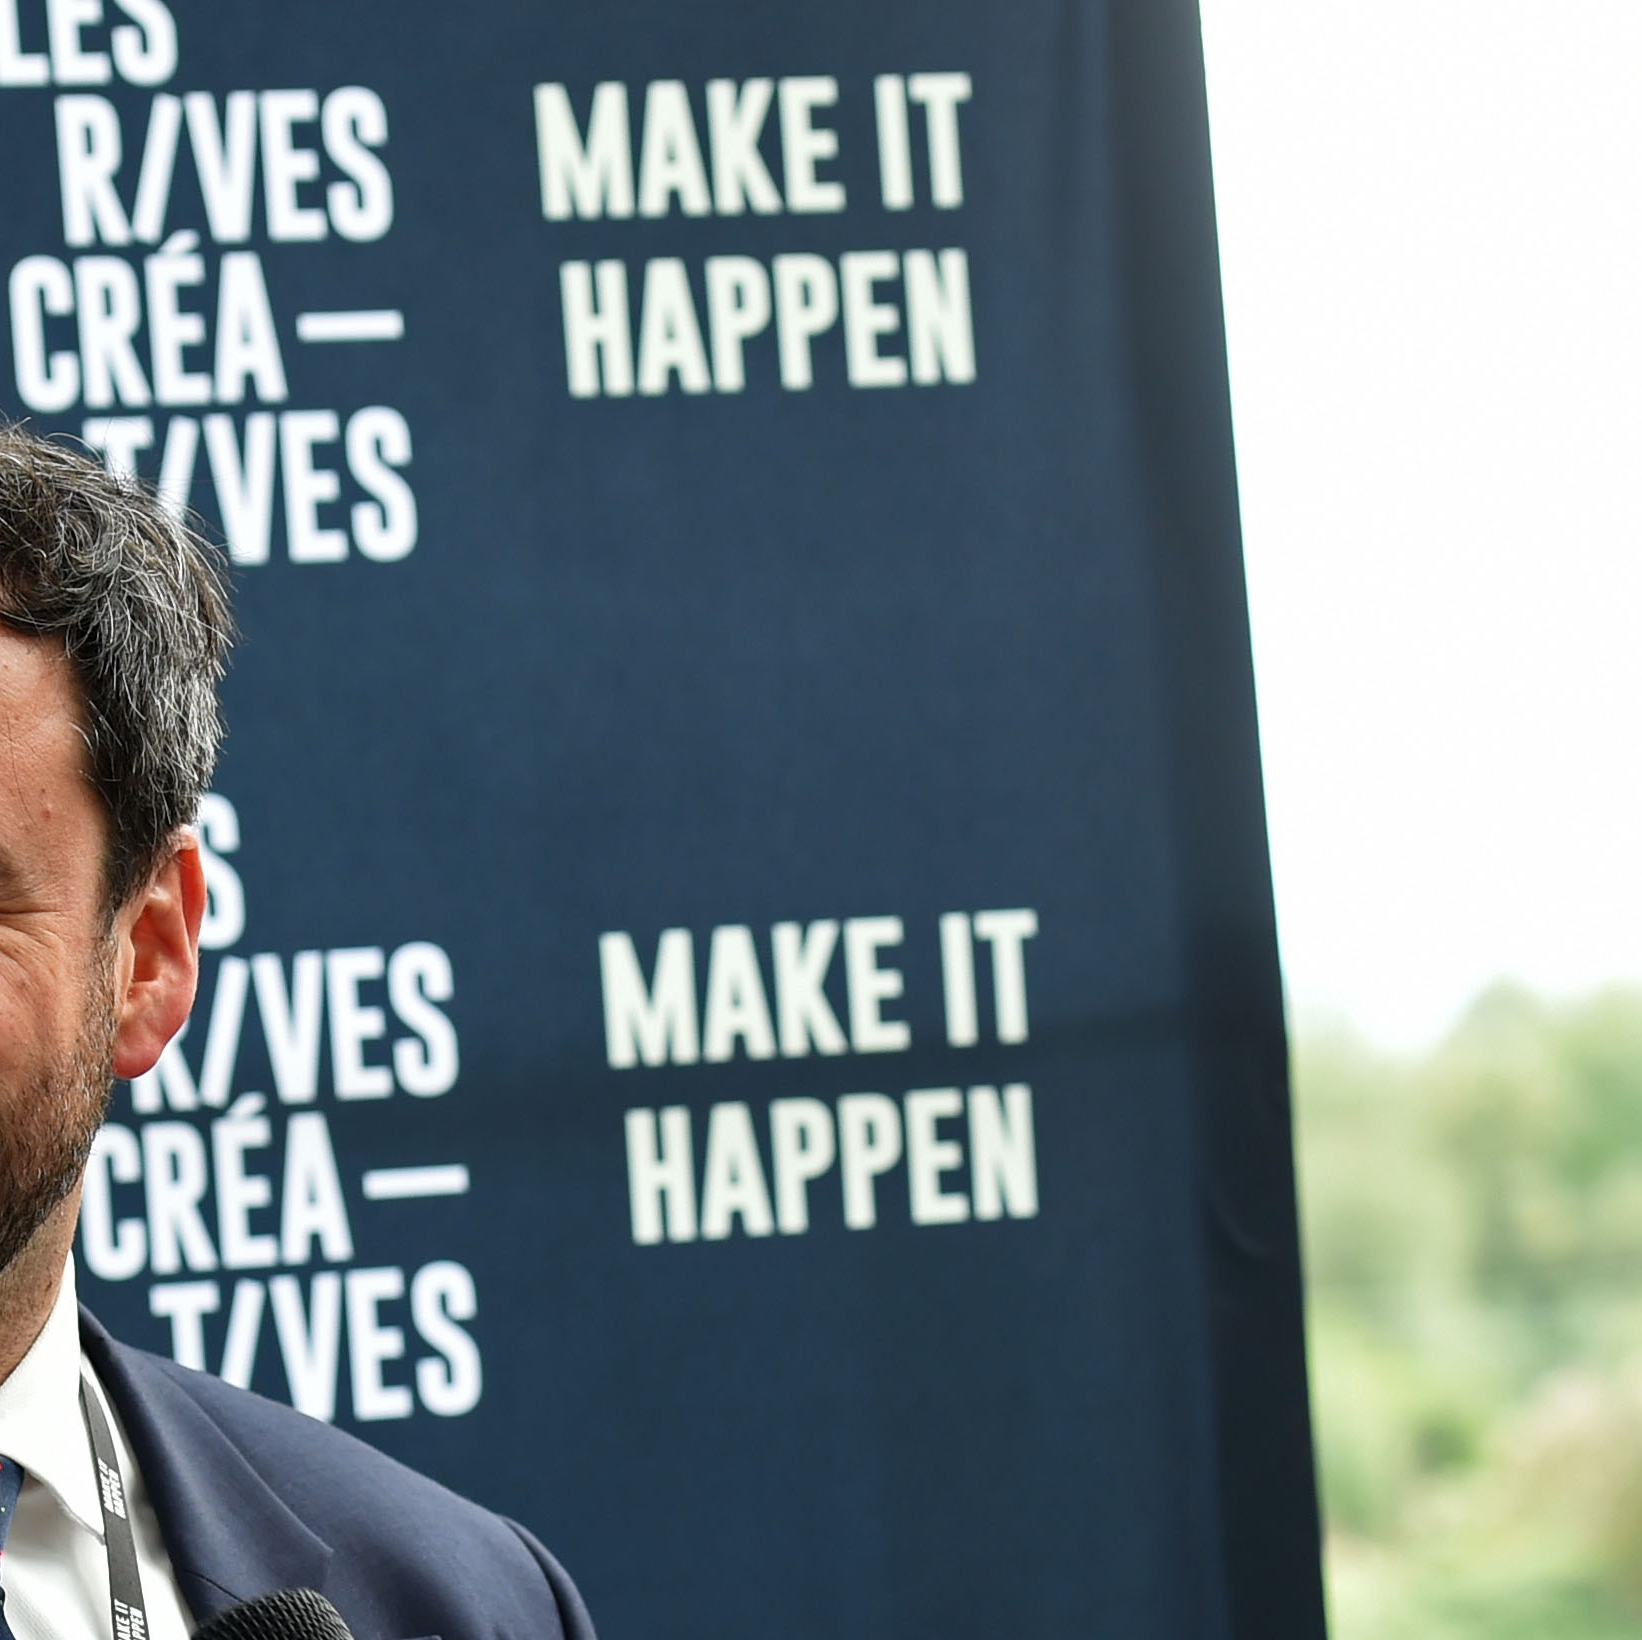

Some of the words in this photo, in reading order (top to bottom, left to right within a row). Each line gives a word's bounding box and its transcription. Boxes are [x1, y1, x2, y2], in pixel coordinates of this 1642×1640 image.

[534, 76, 847, 220] MAKE
[874, 72, 972, 210] IT
[560, 248, 976, 398] HAPPEN
[599, 916, 911, 1069] MAKE
[940, 908, 1038, 1047] IT
[625, 1084, 1038, 1245] HAPPEN
[113, 1598, 129, 1614] IT
